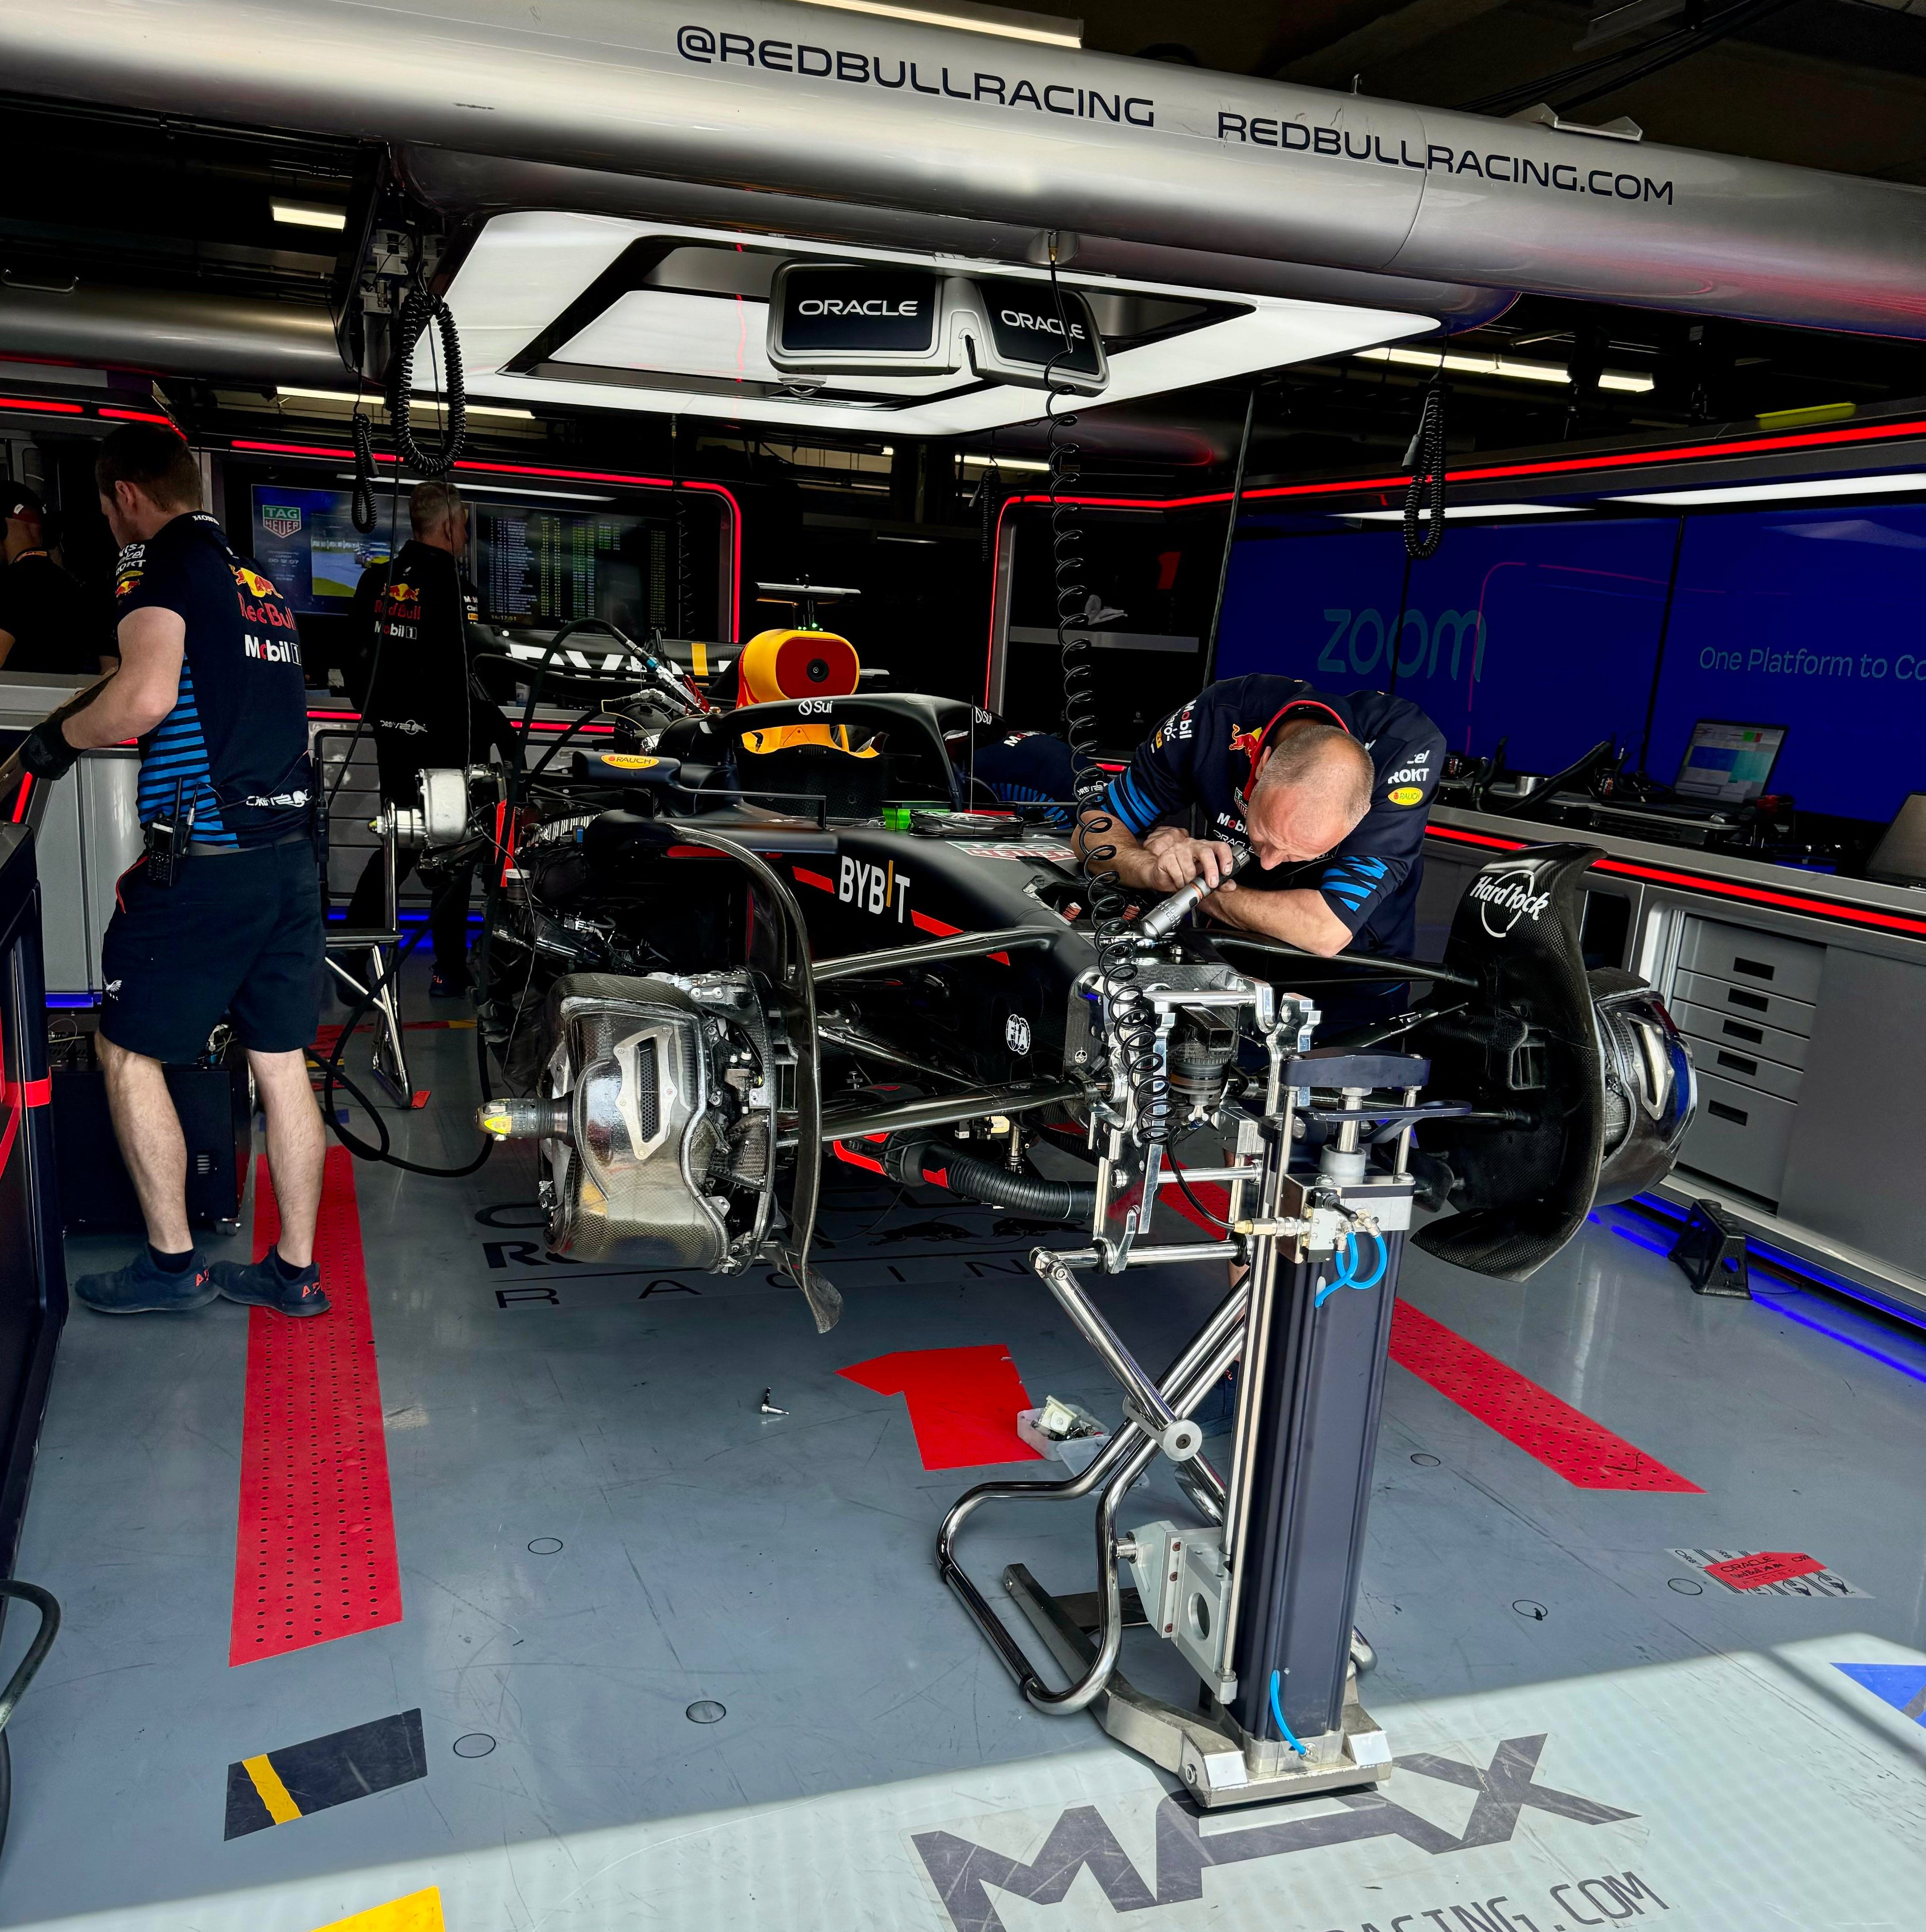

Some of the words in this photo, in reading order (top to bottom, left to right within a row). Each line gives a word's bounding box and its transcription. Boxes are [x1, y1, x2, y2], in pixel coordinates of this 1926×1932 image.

[677, 25, 1155, 127] @REDBULLRACING
[1217, 111, 1674, 205] REDBULLRACING.COM
[798, 300, 918, 316] ORACLE
[1002, 310, 1085, 340] ORACLE
[266, 508, 297, 518] TAG
[265, 520, 298, 535] HEUER
[237, 591, 267, 624] Red
[264, 603, 296, 631] Bull
[374, 600, 399, 616] Rd
[397, 604, 421, 619] Bull
[375, 621, 405, 637] Mobil
[245, 634, 291, 663] Mobil
[1317, 608, 1486, 682] zoom
[1700, 646, 1742, 671] One
[1747, 647, 1853, 677] Platform
[1860, 654, 1887, 678] to
[814, 700, 833, 713] Sui
[983, 710, 993, 725] Sui
[1179, 700, 1197, 739] Mobil
[1388, 768, 1429, 784] ROKT
[1399, 792, 1420, 800] RAUCH
[839, 855, 910, 923] BYBIT
[1470, 876, 1517, 905] Hard
[1720, 1556, 1775, 1572] ORACLE
